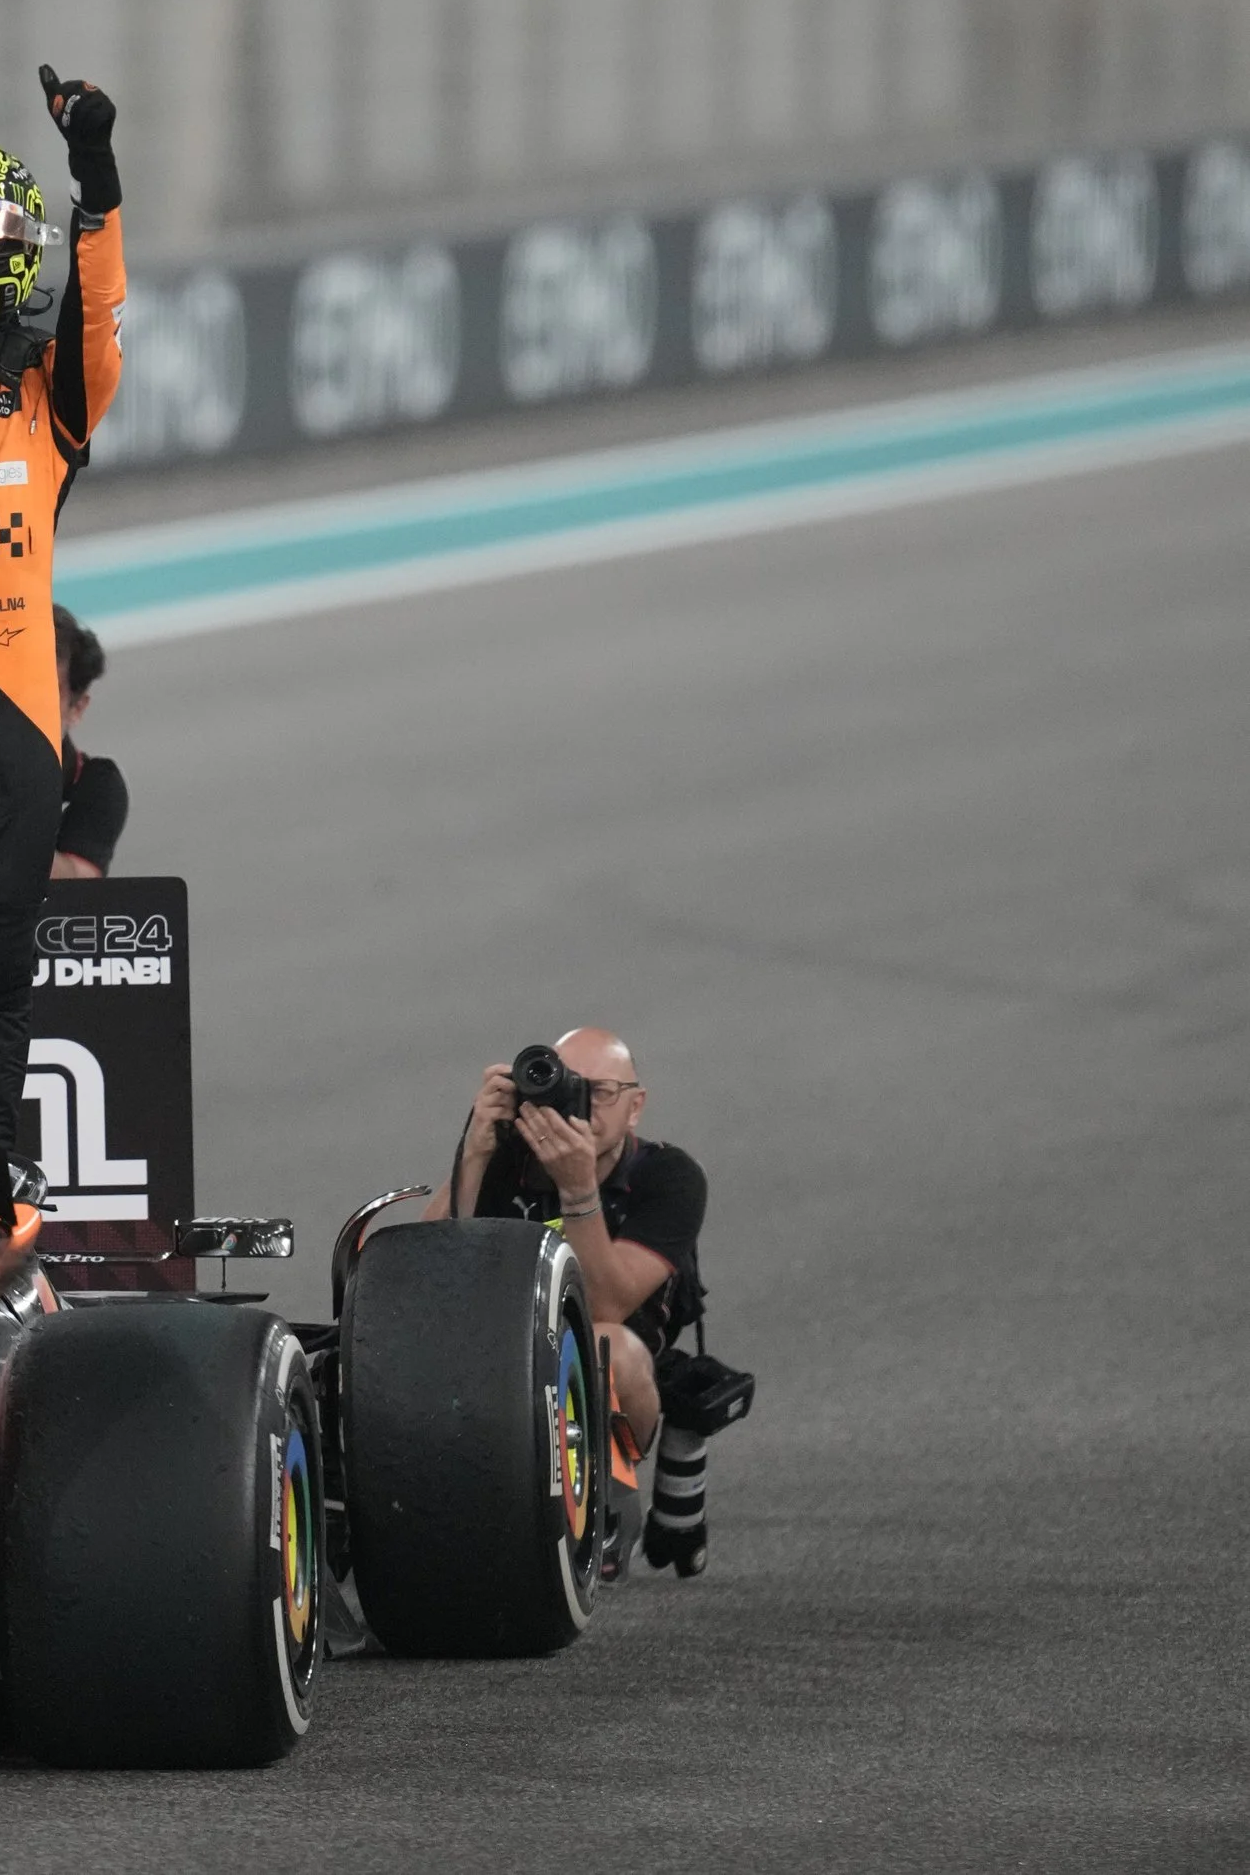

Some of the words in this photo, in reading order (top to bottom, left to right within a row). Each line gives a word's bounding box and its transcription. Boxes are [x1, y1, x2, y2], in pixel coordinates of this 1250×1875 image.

[0, 597, 26, 612] LN4
[34, 915, 97, 954] CE
[103, 914, 173, 953] 24
[54, 956, 172, 987] DHABI
